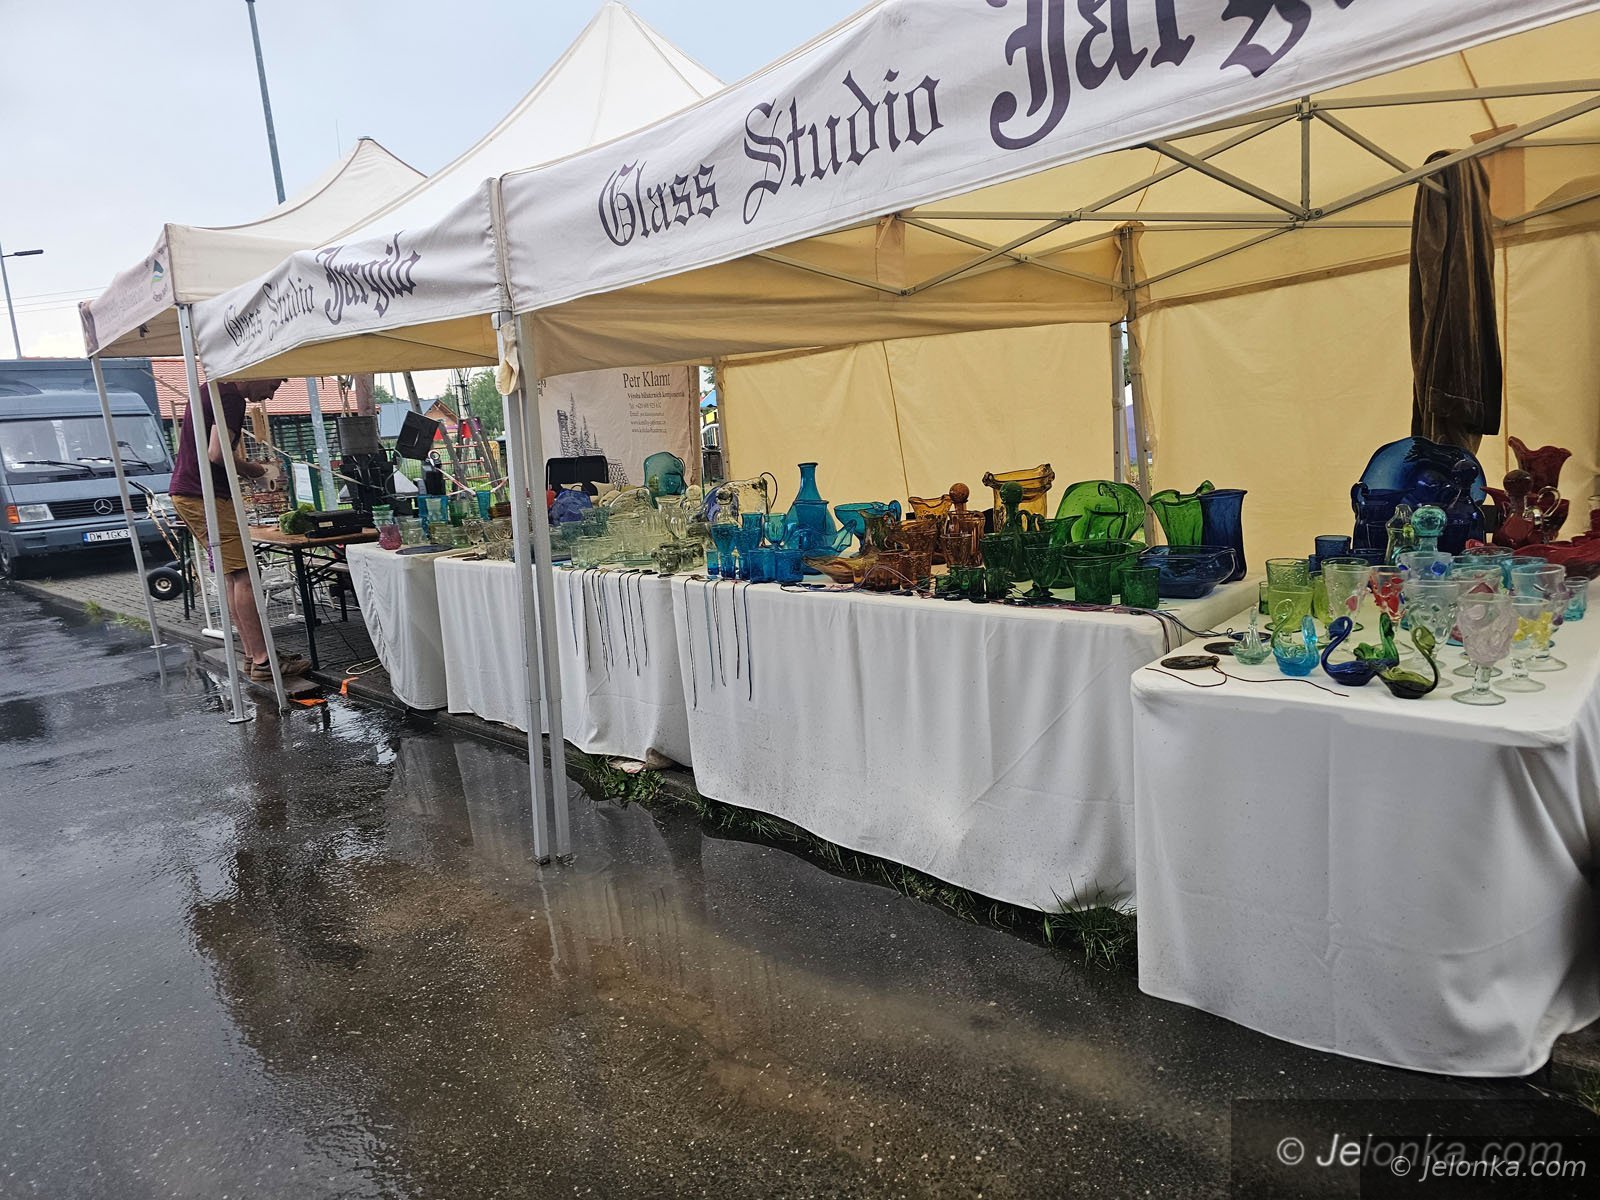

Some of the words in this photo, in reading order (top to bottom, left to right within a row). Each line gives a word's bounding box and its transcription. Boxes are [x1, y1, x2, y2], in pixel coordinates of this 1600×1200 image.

[598, 159, 720, 247] Glass
[743, 69, 945, 225] Studio
[262, 276, 315, 342] Studio
[622, 372, 641, 388] Petr
[642, 370, 671, 387] Klamt
[89, 532, 102, 542] DW
[106, 530, 130, 540] 1GK3
